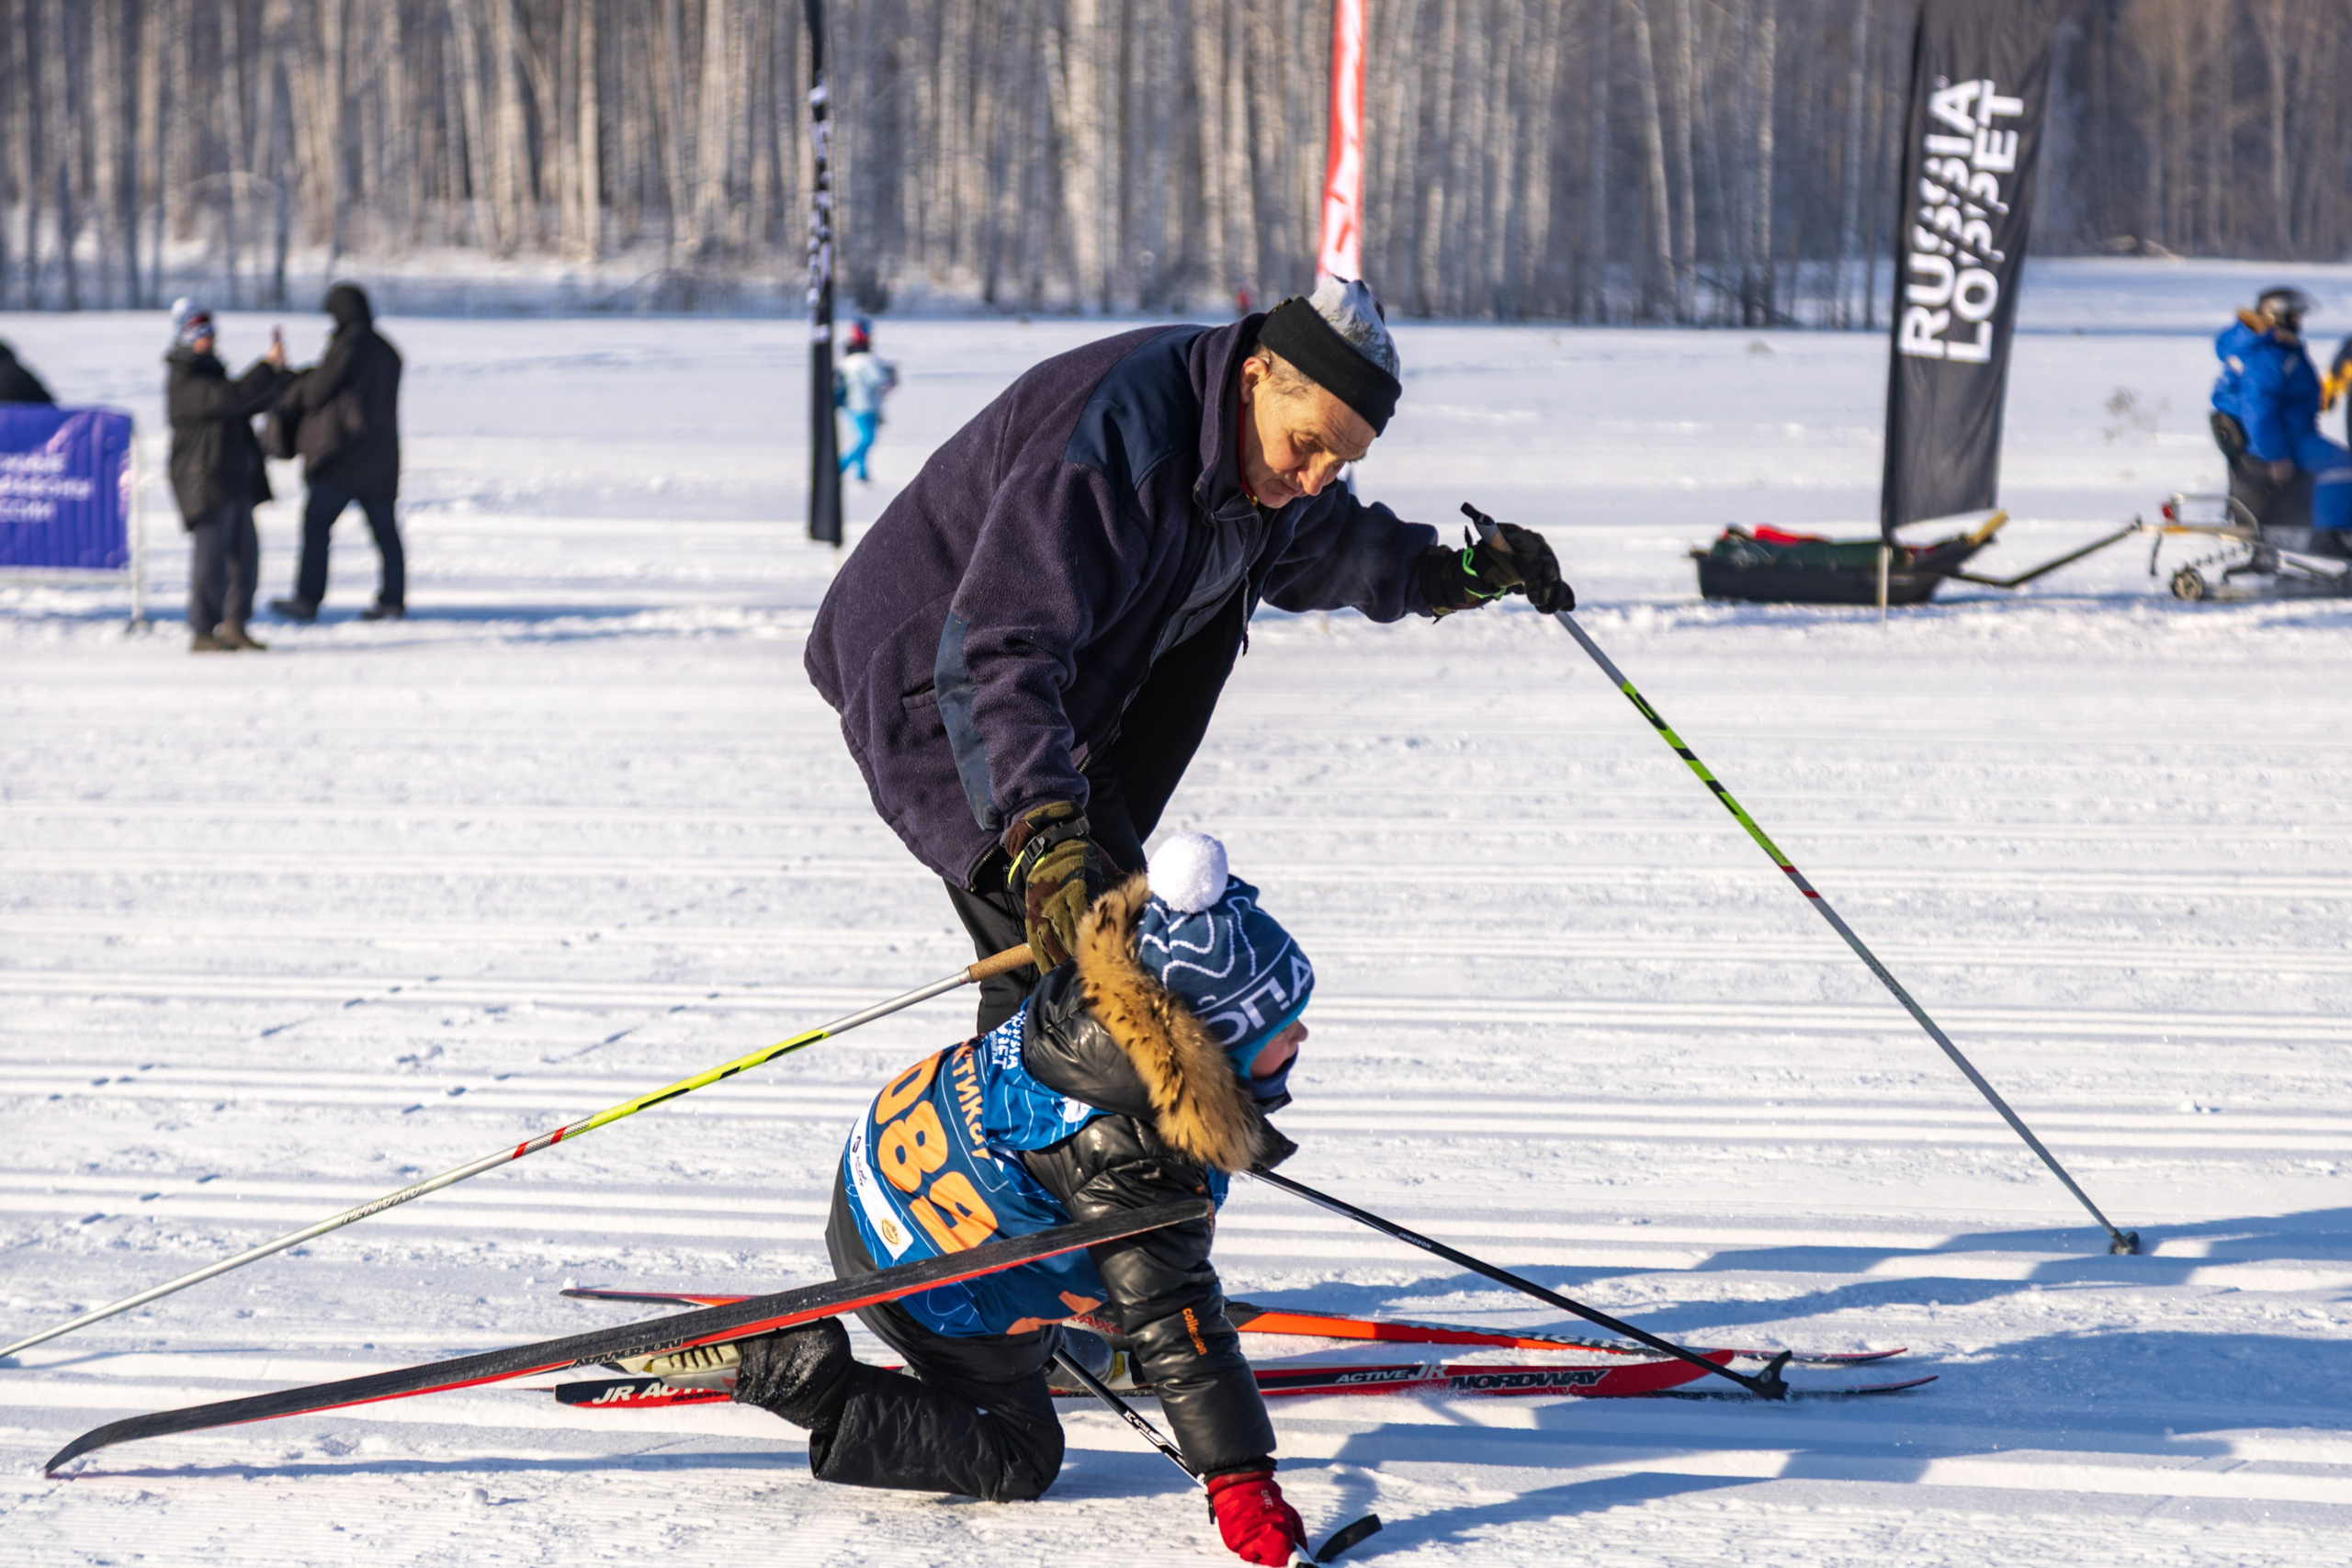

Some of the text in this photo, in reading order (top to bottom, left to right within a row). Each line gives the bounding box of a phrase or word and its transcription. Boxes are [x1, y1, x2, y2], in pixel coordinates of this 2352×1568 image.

[1897, 79, 1982, 358] RUSSIA
[1945, 79, 2024, 364] LOPPET
[342, 1181, 427, 1225] AVANTI
[875, 1049, 1000, 1255] 089
[592, 1386, 635, 1404] JR
[1335, 1363, 1614, 1391] ACTIVE JR NORDWAY
